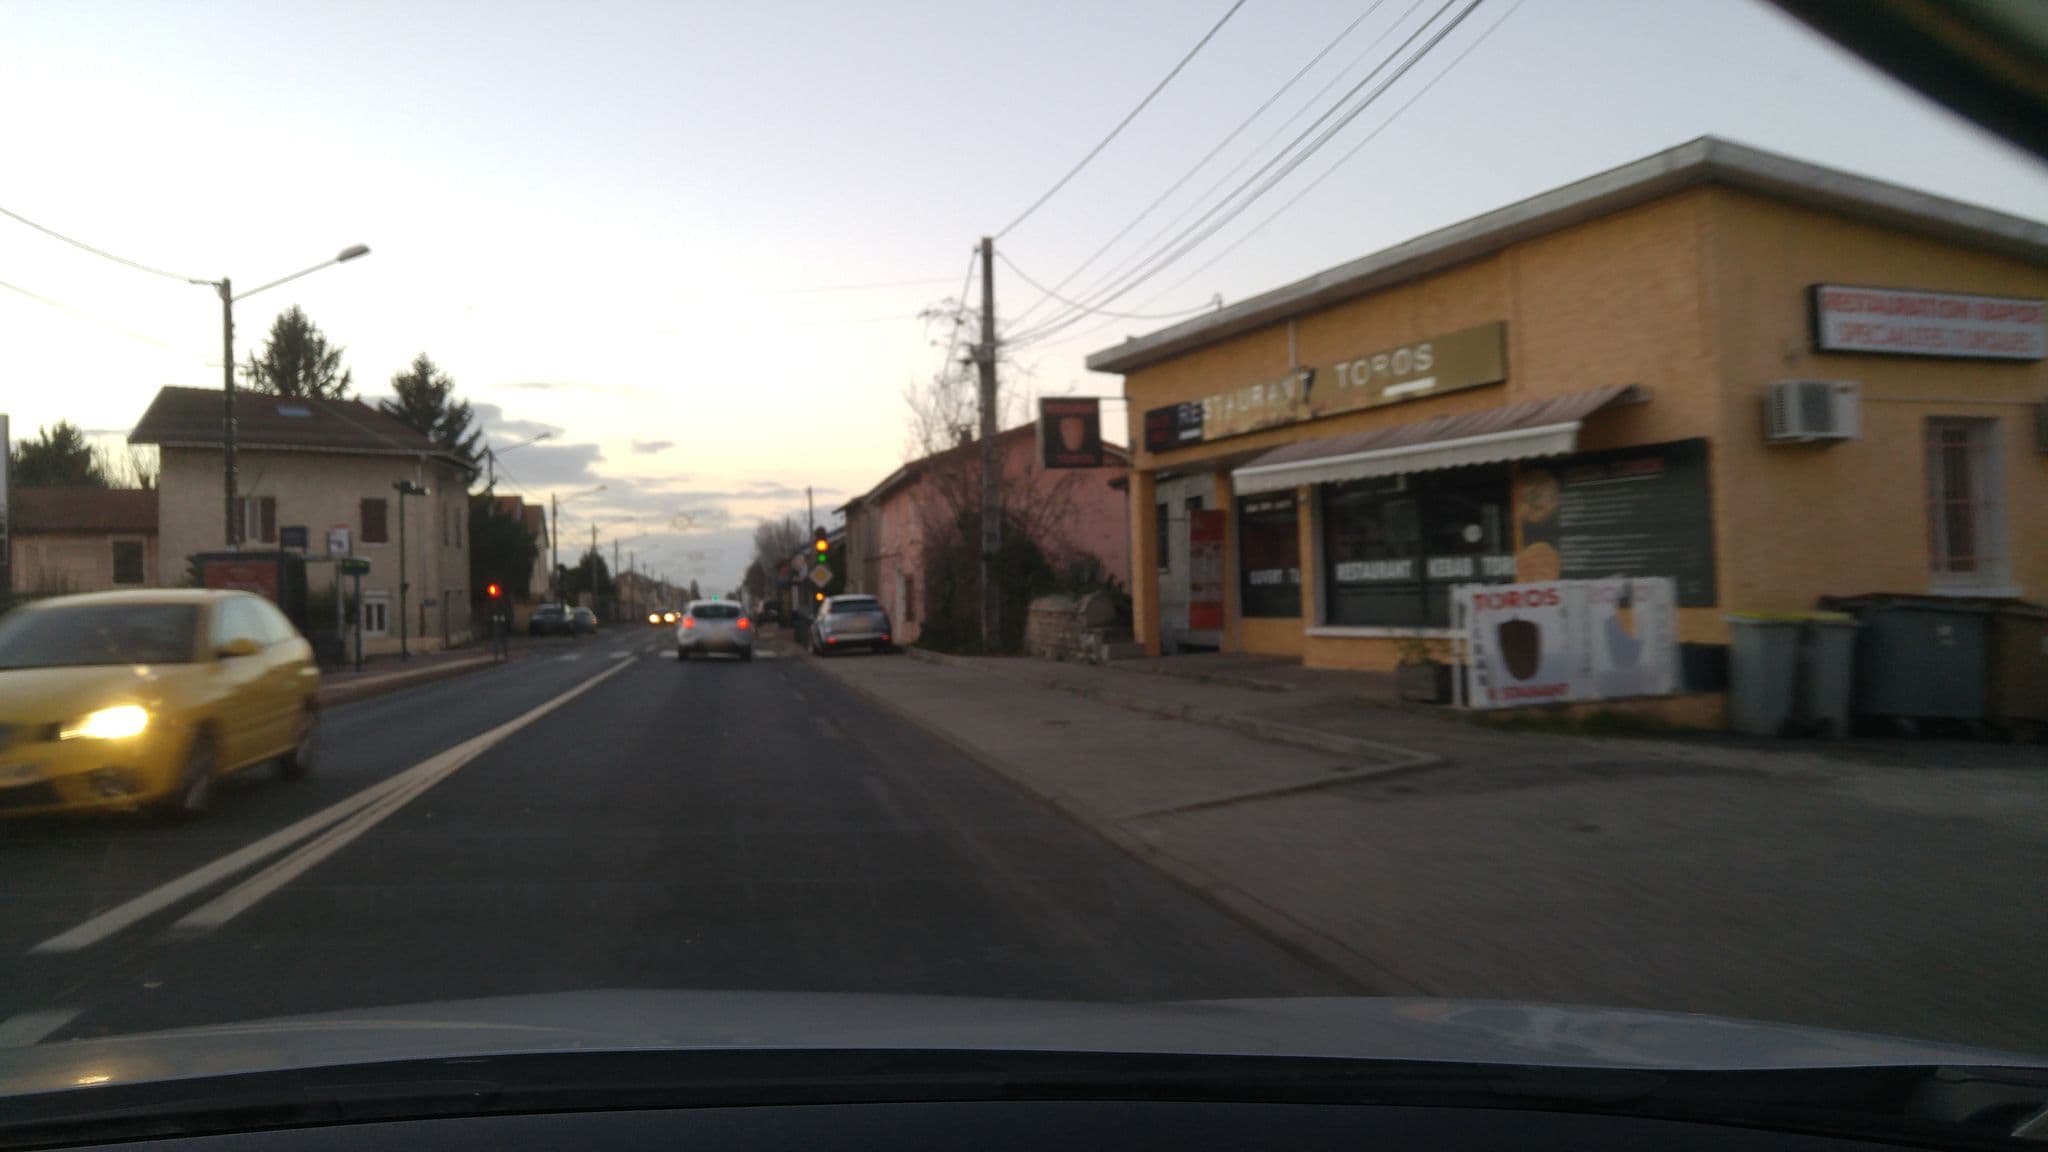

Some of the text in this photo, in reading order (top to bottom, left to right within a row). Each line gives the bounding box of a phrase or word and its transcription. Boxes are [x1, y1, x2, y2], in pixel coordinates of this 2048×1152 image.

[1334, 343, 1435, 388] TOROS
[1336, 560, 1411, 581] RESTAURANT
[1427, 557, 1473, 578] KEBAB
[1473, 589, 1560, 611] TOROS
